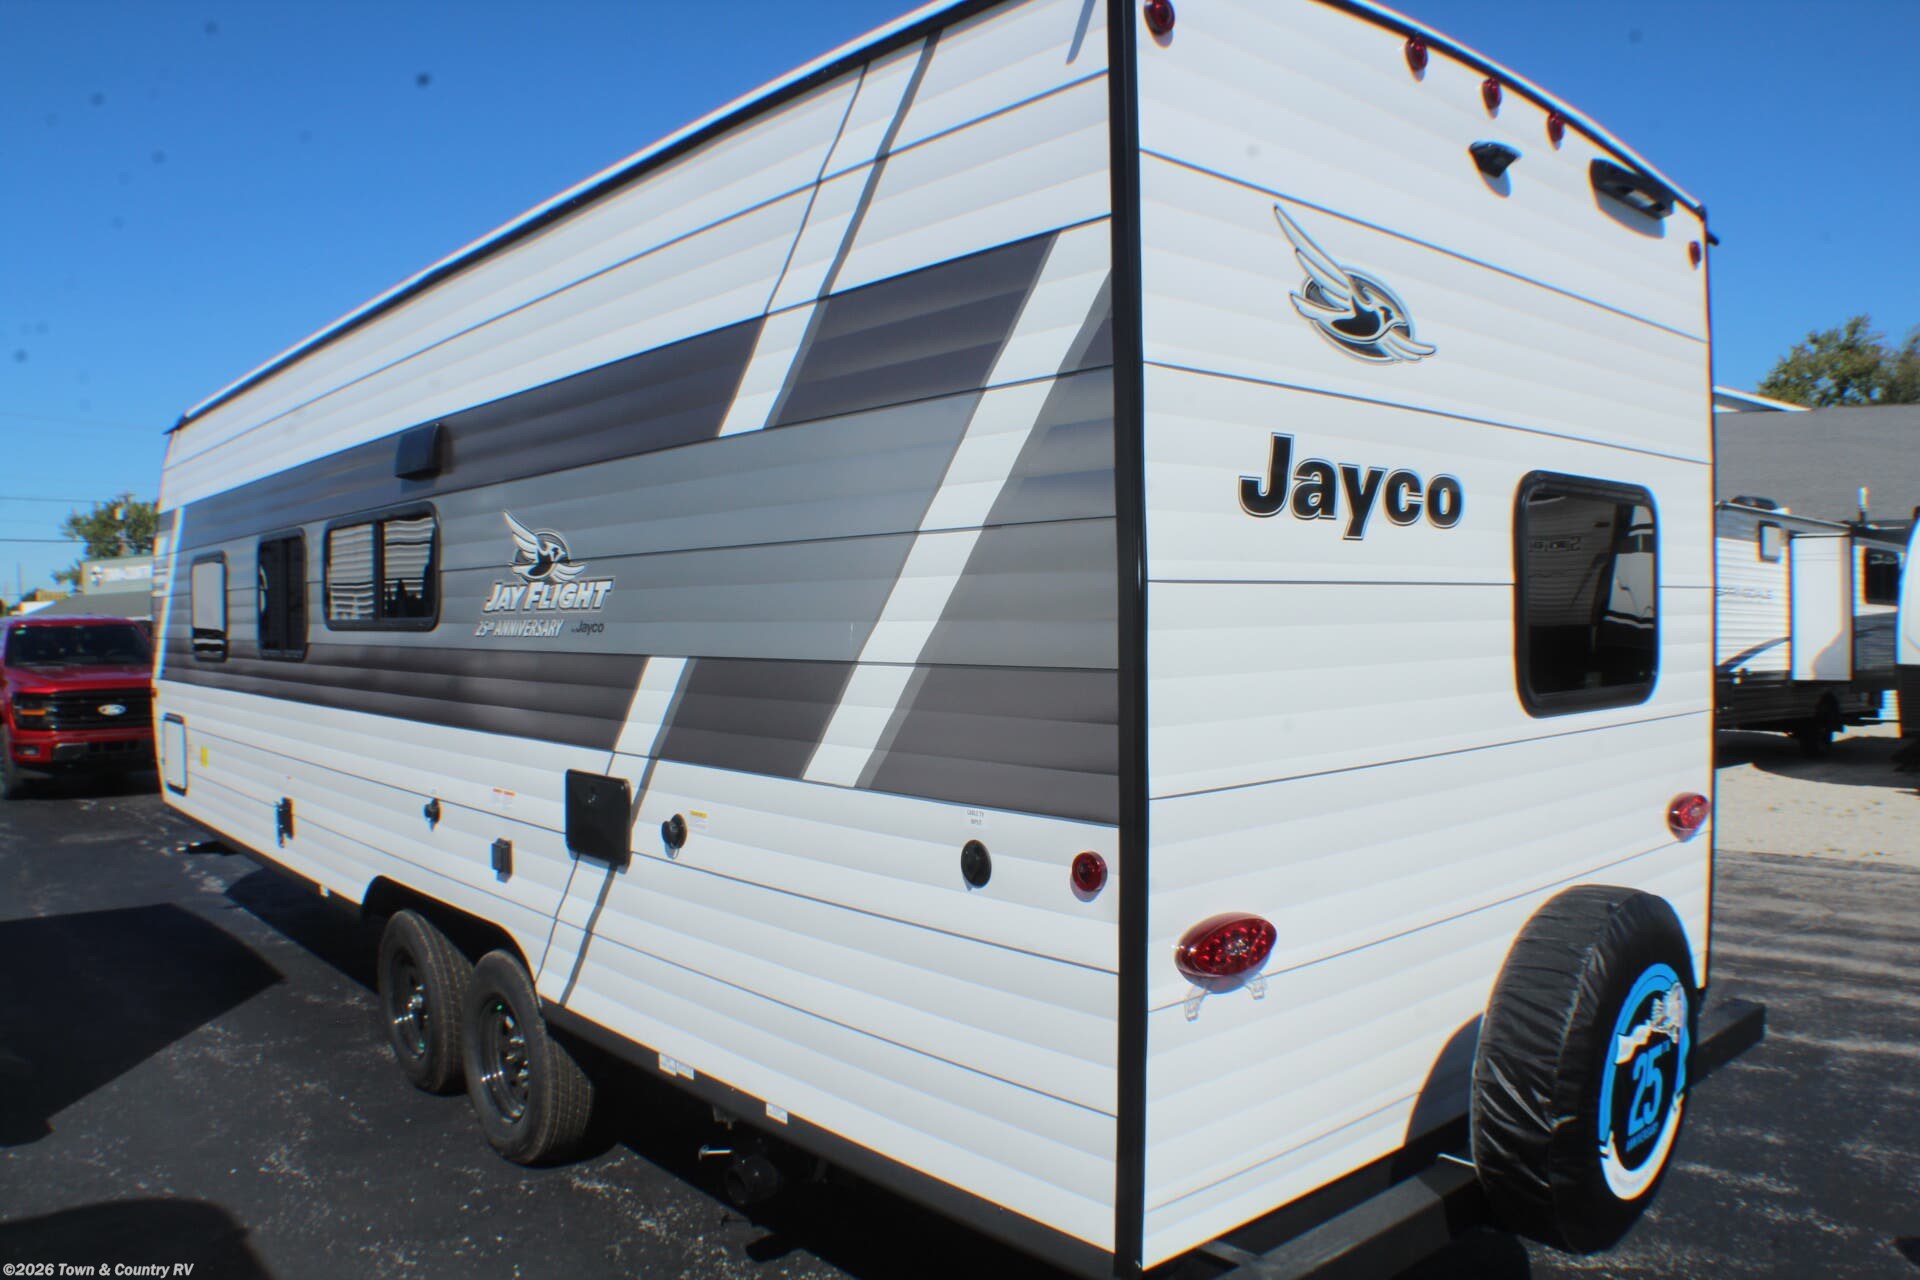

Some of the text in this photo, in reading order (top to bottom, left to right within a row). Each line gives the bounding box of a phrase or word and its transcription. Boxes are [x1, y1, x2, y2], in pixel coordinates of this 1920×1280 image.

[1238, 432, 1463, 540] Jayco
[482, 577, 615, 613] JAY FLIGHT
[493, 619, 564, 637] ANNIVERSARY
[575, 620, 605, 635] Jayco
[1627, 1045, 1663, 1136] 25
